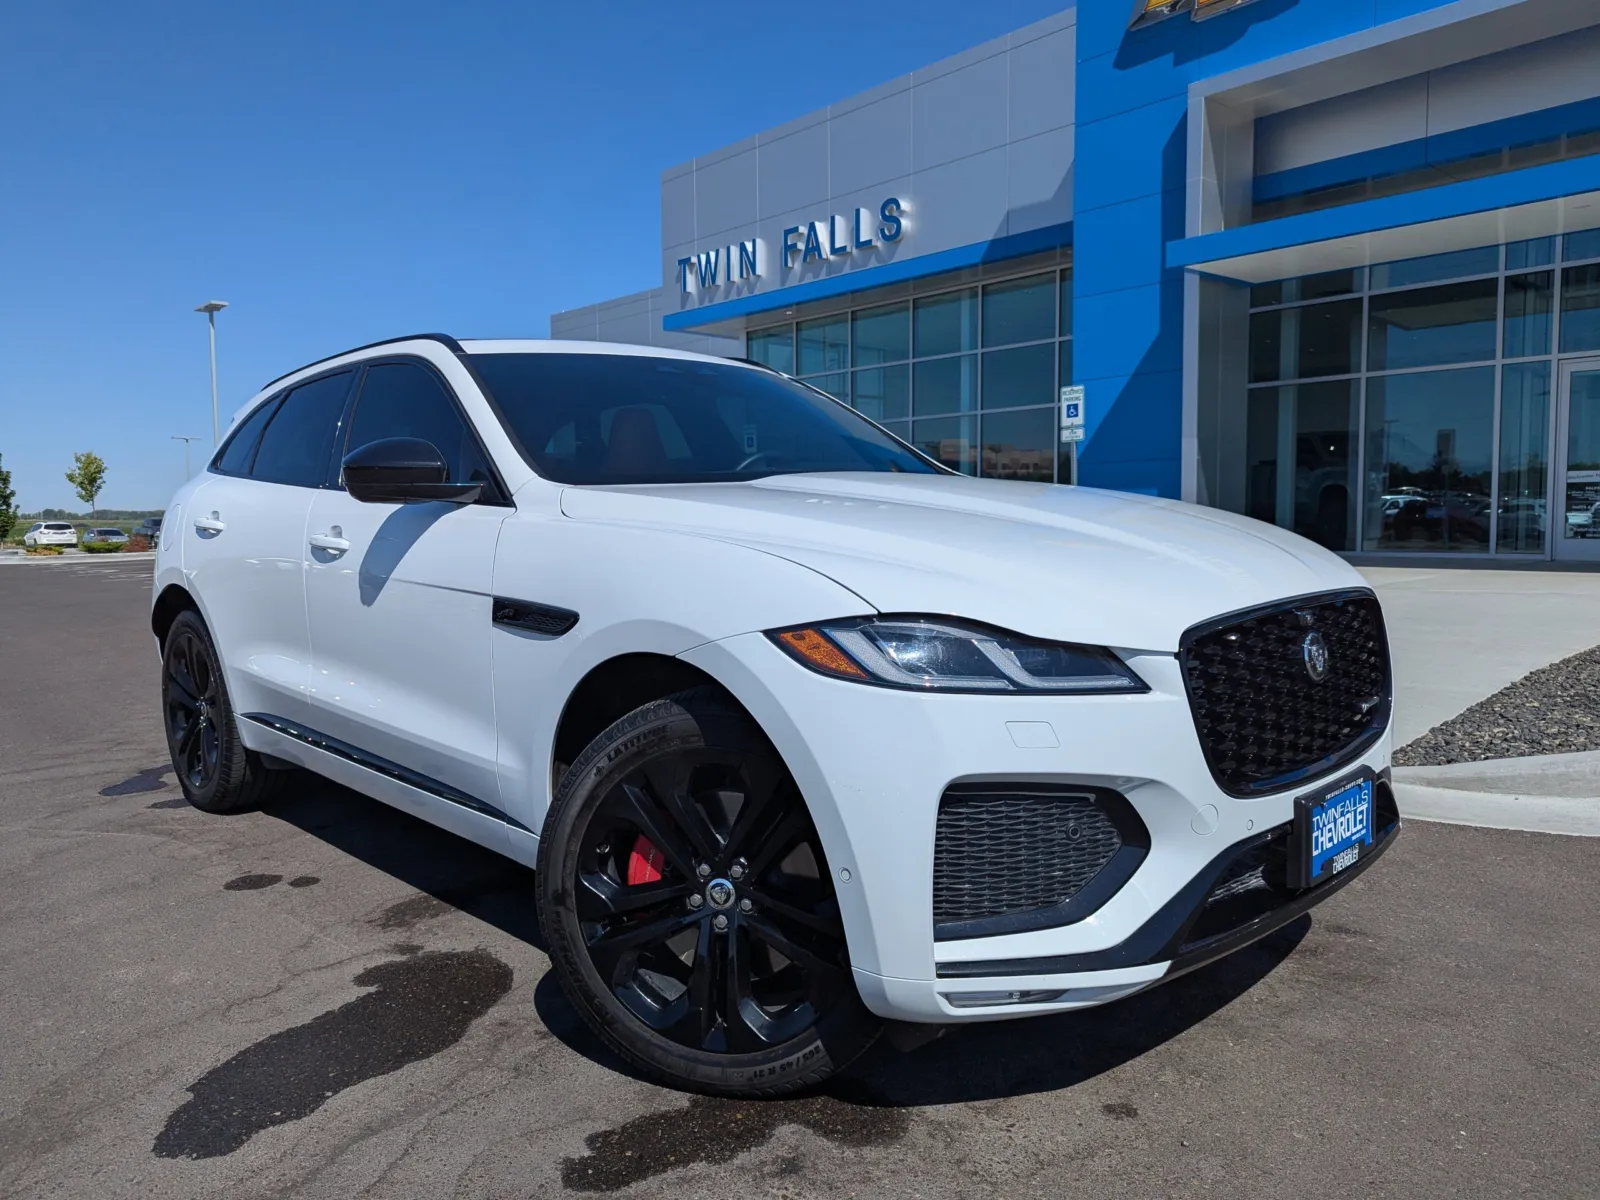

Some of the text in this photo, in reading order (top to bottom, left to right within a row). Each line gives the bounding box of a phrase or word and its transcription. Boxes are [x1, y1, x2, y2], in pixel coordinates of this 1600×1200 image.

[677, 197, 904, 293] TWIN FALLS
[1312, 803, 1369, 857] CHEVROLET
[1332, 850, 1359, 875] CHEVROLET
